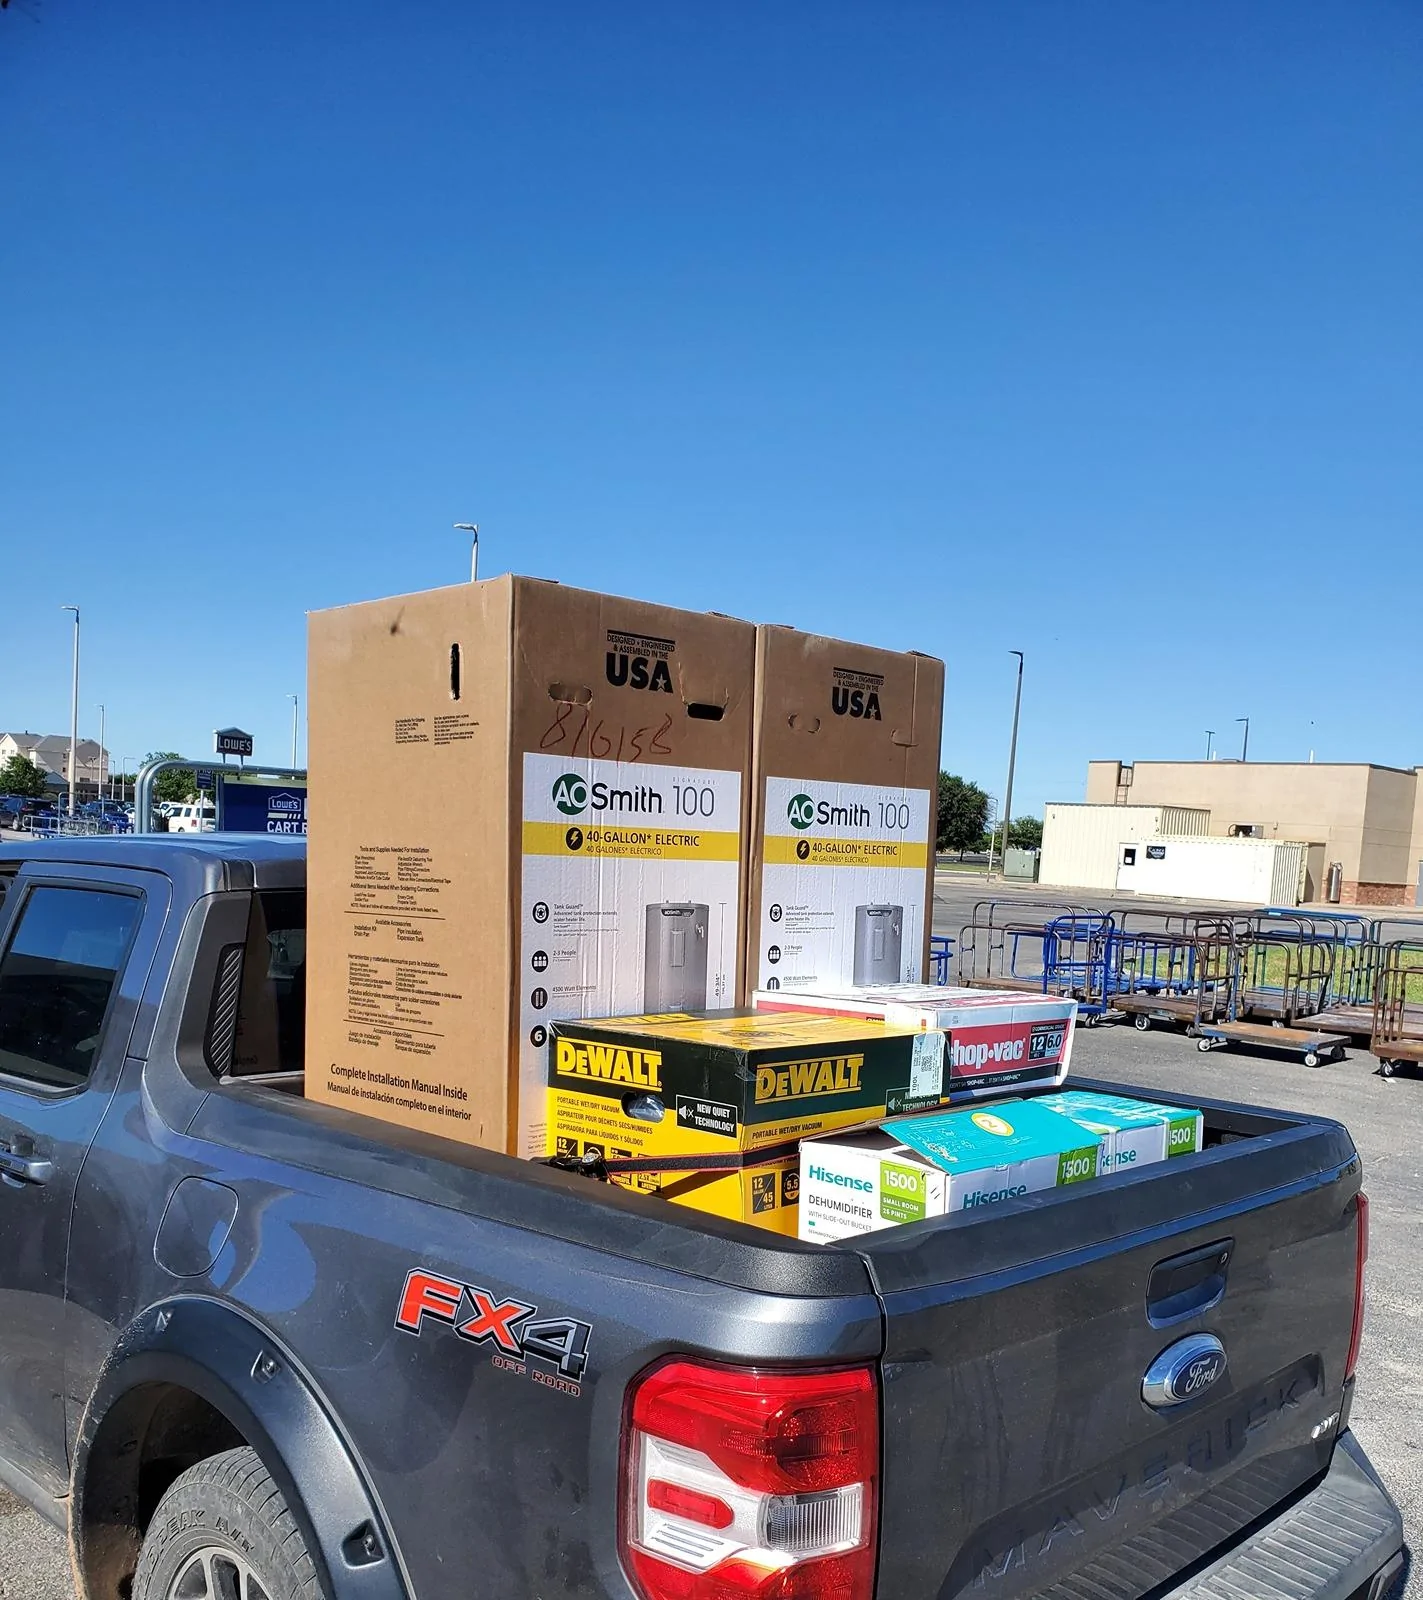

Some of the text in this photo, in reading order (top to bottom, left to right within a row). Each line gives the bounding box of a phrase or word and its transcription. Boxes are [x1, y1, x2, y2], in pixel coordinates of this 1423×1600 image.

[607, 634, 675, 652] DESIGNED ENGINEERED
[619, 644, 651, 657] ASSEMBLED
[651, 650, 658, 658] IN
[659, 651, 668, 660] THE
[606, 651, 673, 694] USA
[832, 686, 882, 721] USA
[218, 736, 251, 751] LOWE'S
[272, 799, 298, 809] LOWE'S
[673, 785, 714, 817] 100
[878, 803, 910, 829] 100
[267, 821, 299, 834] CART
[655, 834, 700, 846] ELECTRIC
[864, 845, 897, 855] ELECTRIC
[535, 1030, 542, 1040] 6
[1032, 1034, 1062, 1051] 12 6.0
[331, 1063, 468, 1101] Complete Installation Manual Inside
[327, 1081, 471, 1121] Manual de instalación completo en el interior
[557, 1096, 620, 1113] PORTABLE WET/DRY VACUUM
[697, 1103, 731, 1118] NEW QUIET
[557, 1109, 653, 1134] ASPIRATEUR POUR DÉCHETS SECS/HUMIDES
[694, 1116, 735, 1133] TECHNOLOGY
[557, 1122, 585, 1133] ASPIRADORA
[586, 1127, 598, 1136] PARA
[599, 1129, 618, 1141] LÍQUIDOS
[624, 1136, 643, 1146] SÓLIDOS
[752, 1122, 822, 1139] PORTABLE WET/DRY VACUUM
[557, 1138, 567, 1149] 12
[1062, 1157, 1090, 1178] 1500
[753, 1177, 764, 1189] 12
[787, 1179, 798, 1190] 5.5
[808, 1164, 873, 1193] Hisense
[883, 1170, 918, 1192] 1500
[763, 1192, 773, 1203] 45
[883, 1197, 919, 1212] SMALL ROOM
[962, 1184, 1027, 1209] Hisense
[808, 1194, 872, 1219] DEHUMIDIFIER
[890, 1210, 907, 1219] PINTS
[808, 1210, 872, 1232] WITH SLIDE-OUT BUCKET
[394, 1267, 593, 1383] FX4
[491, 1354, 580, 1397] OFF ROAD
[1185, 1357, 1219, 1393] Ford
